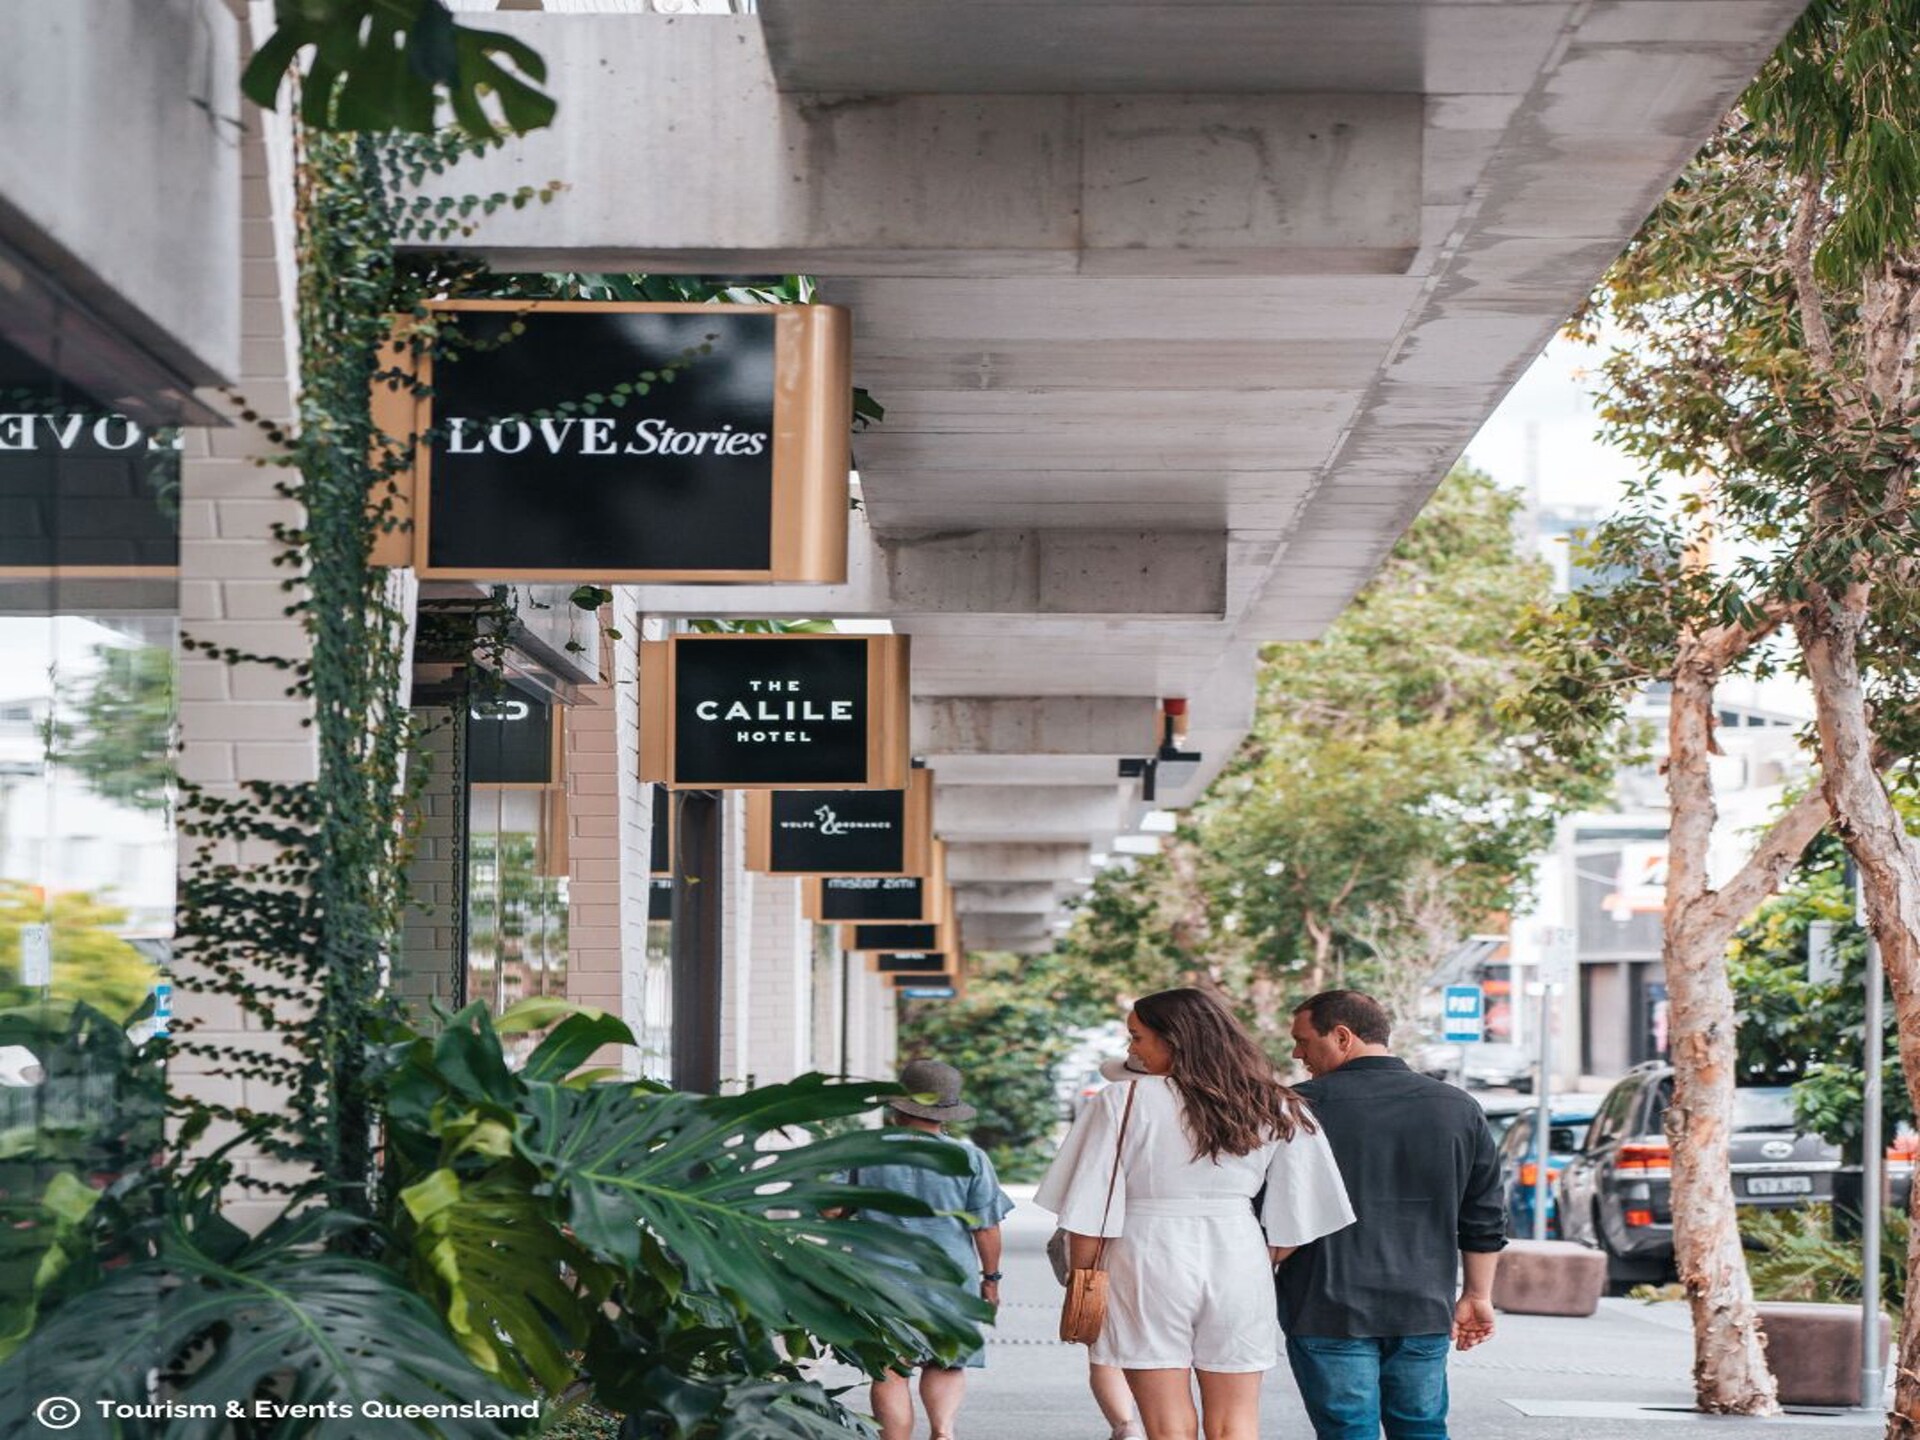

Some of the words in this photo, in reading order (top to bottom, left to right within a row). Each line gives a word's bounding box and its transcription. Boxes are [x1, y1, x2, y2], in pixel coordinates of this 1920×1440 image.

[446, 417, 617, 455] LOVE
[624, 418, 767, 456] Stories
[749, 680, 800, 692] THE
[695, 700, 853, 721] CALILE
[737, 731, 812, 742] HOTEL
